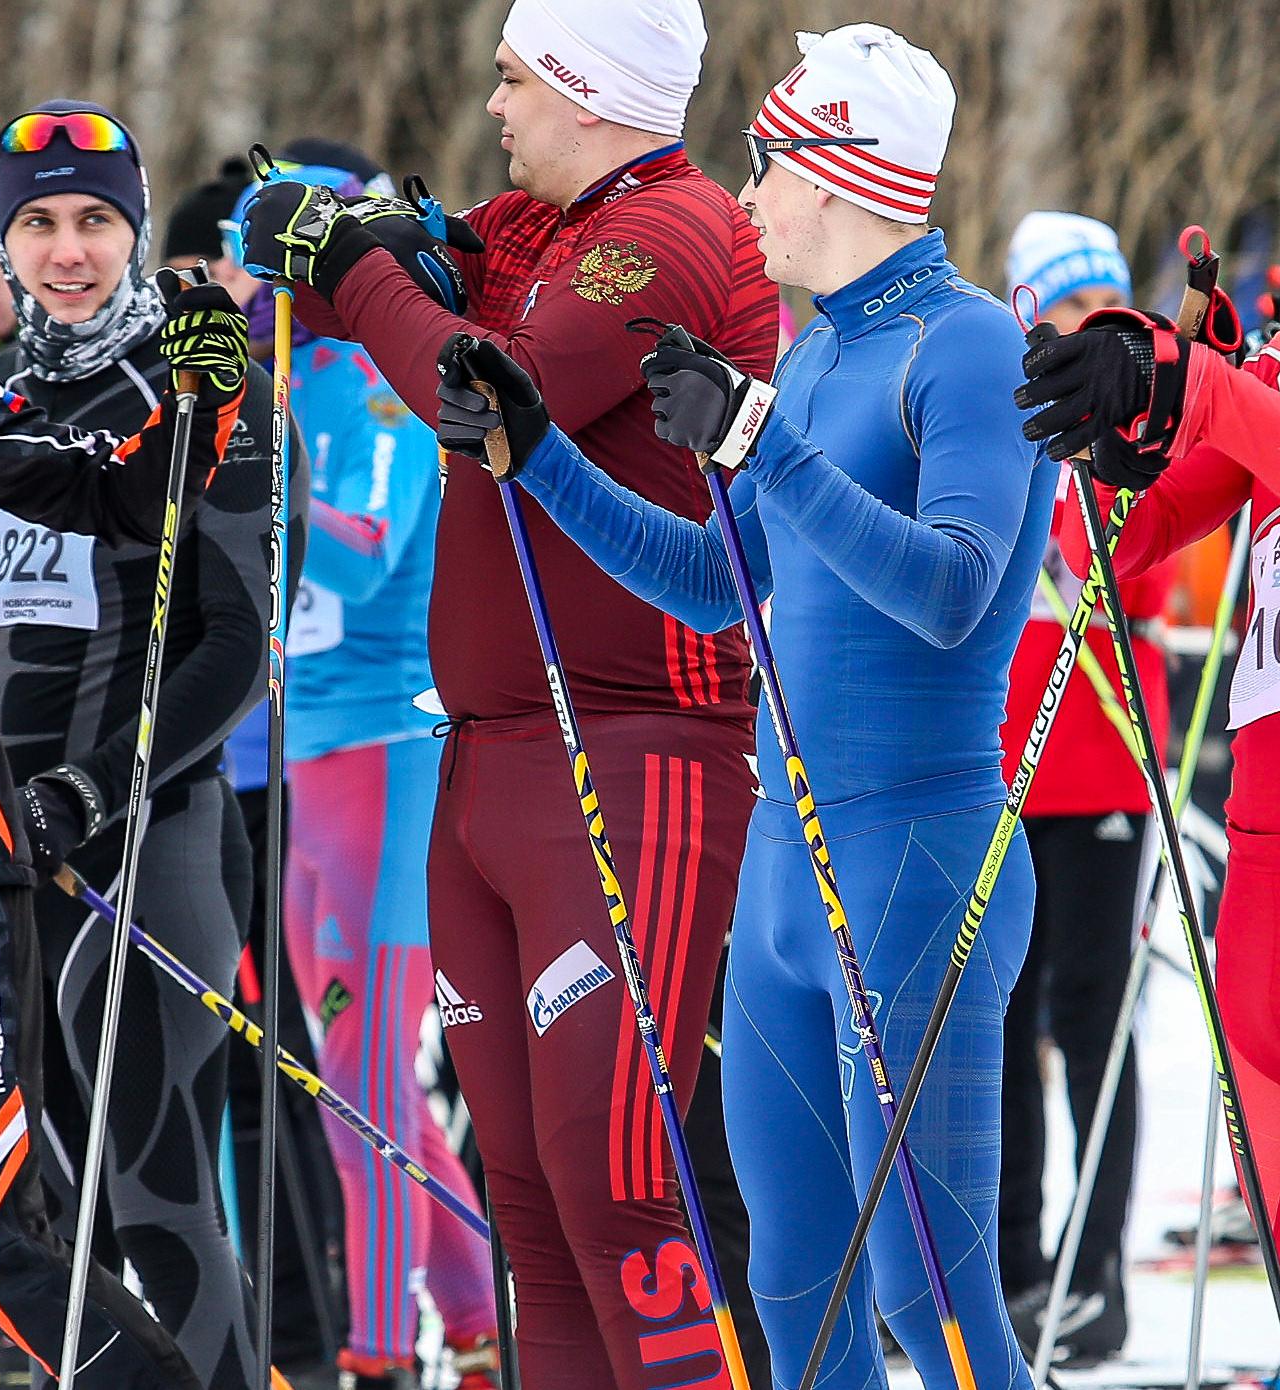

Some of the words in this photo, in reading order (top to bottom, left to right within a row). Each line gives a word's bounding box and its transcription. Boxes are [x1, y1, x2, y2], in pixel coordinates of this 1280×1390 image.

[536, 53, 600, 100] Swix
[811, 106, 854, 135] adidas
[863, 267, 933, 316] odlo
[741, 396, 767, 440] Swix
[148, 498, 177, 641] SWIX
[977, 815, 1014, 897] PROGRESSIVE
[550, 964, 612, 1015] GAZPROM
[441, 1004, 484, 1029] idas
